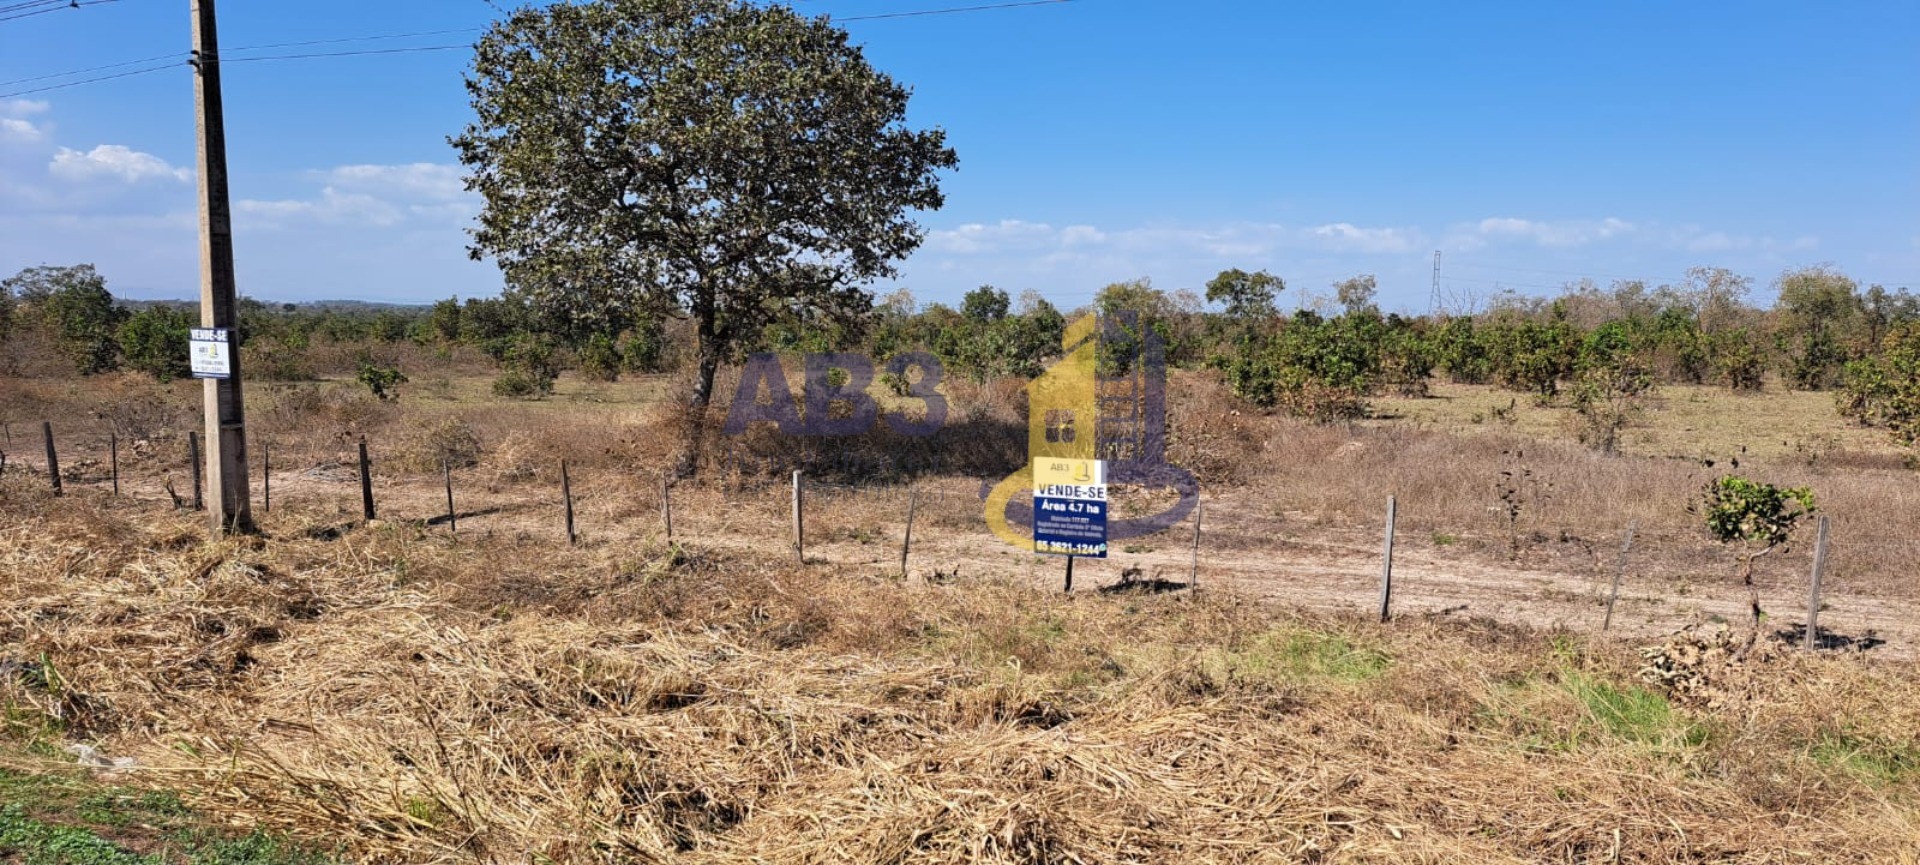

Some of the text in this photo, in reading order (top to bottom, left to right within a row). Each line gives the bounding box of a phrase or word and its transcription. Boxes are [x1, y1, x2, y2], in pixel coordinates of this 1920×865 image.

[1050, 463, 1070, 472] AB3
[1039, 484, 1104, 498] VENDE-SE
[1042, 499, 1100, 514] Área 4.7 ha
